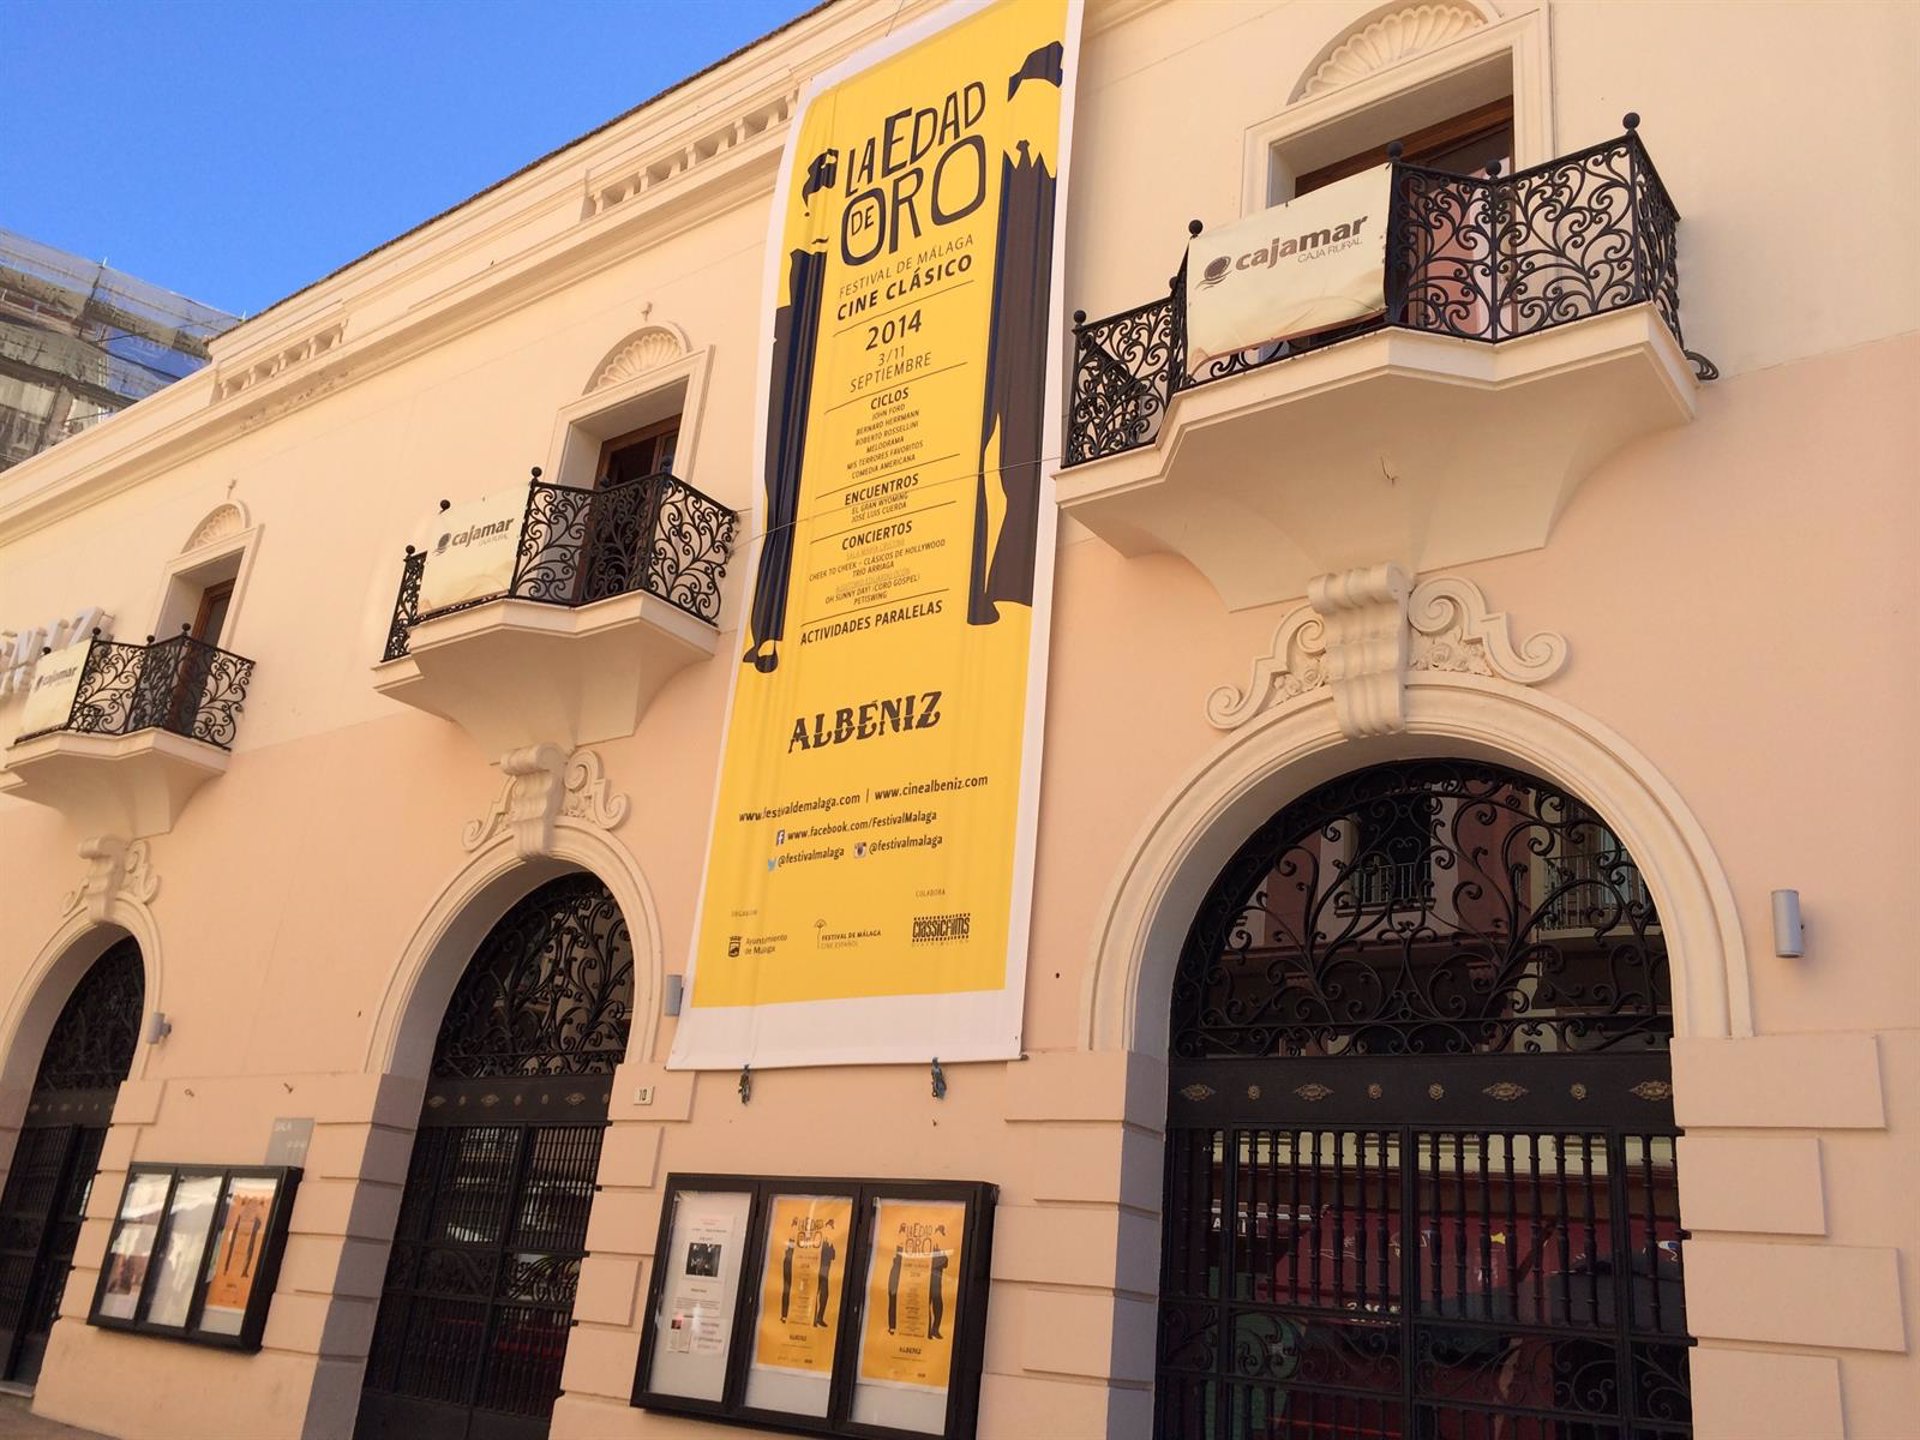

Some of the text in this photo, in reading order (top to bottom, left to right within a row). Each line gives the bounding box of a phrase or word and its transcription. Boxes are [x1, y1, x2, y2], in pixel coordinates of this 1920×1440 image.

[844, 81, 986, 199] LA EDAD
[840, 133, 987, 266] ORO
[851, 205, 875, 236] DE
[1235, 215, 1369, 271] cajamar
[1297, 238, 1364, 264] CAJA RURAL
[837, 254, 972, 321] CINE CLÁSICO
[839, 268, 892, 299] FESTIVAL
[896, 256, 913, 274] DE
[865, 309, 922, 351] 2014
[878, 345, 905, 367] 3/11
[849, 351, 932, 393] SEPTIEMBRE
[870, 387, 910, 410] CICLOS
[872, 403, 906, 421] JOHN FORD
[855, 420, 919, 447] ROBERTO ROSSELLINI
[856, 409, 920, 436] BERNARD HERRMANN
[866, 435, 905, 454] MELODRAMA
[889, 439, 924, 457] FAVORITOS
[851, 453, 916, 480] COMEDIA AMERICANA
[844, 473, 919, 506] ENCUENTROS
[881, 501, 907, 516] CUERDA
[451, 517, 515, 548] cajamar
[841, 519, 914, 551] CONCIERTOS
[808, 569, 828, 582] CHEEK
[828, 566, 838, 577] TO
[837, 561, 858, 575] CHEEK
[894, 547, 904, 559] DE
[904, 538, 946, 556] HOLLYWOOD
[835, 589, 856, 602] SUNNY
[800, 600, 944, 647] ACTIVIDADES PARALELAS
[788, 691, 943, 754] ALBENIZ
[874, 775, 989, 801] www.cinealbeniz.com
[787, 811, 938, 842] www.facebook.com/FestivalMalaga
[777, 834, 944, 868] @festivalmalaga @festivalmalaga
[821, 933, 848, 942] FESTIVAL
[848, 931, 857, 939] DE
